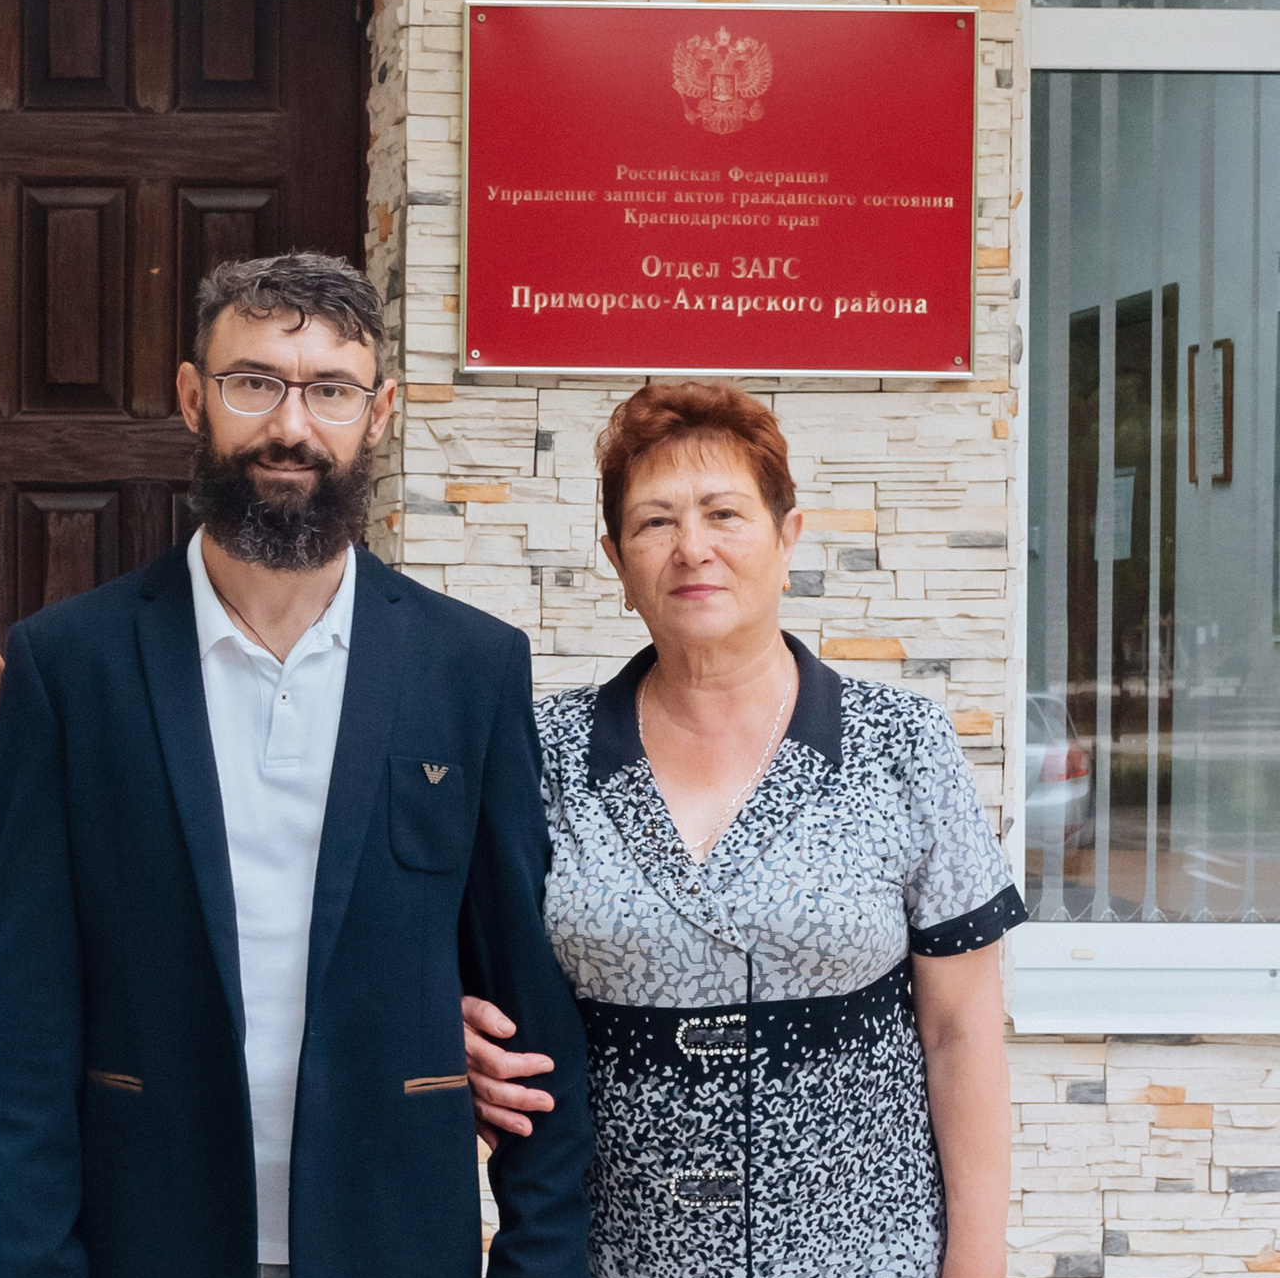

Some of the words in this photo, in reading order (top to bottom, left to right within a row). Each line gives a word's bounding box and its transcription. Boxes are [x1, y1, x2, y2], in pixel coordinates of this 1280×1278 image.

[615, 164, 721, 182] Российская
[727, 166, 828, 188] Федерация
[487, 185, 597, 206] Управление
[603, 190, 667, 203] записи
[673, 191, 725, 204] актов
[731, 192, 856, 209] гражданского
[863, 195, 954, 209] состояния
[623, 207, 771, 230] Краснодарского
[777, 215, 819, 232] края
[641, 255, 720, 281] Отдел
[731, 256, 799, 280] ЗАГС
[510, 285, 824, 318] Приморско-Ахтарского
[833, 291, 928, 320] района
